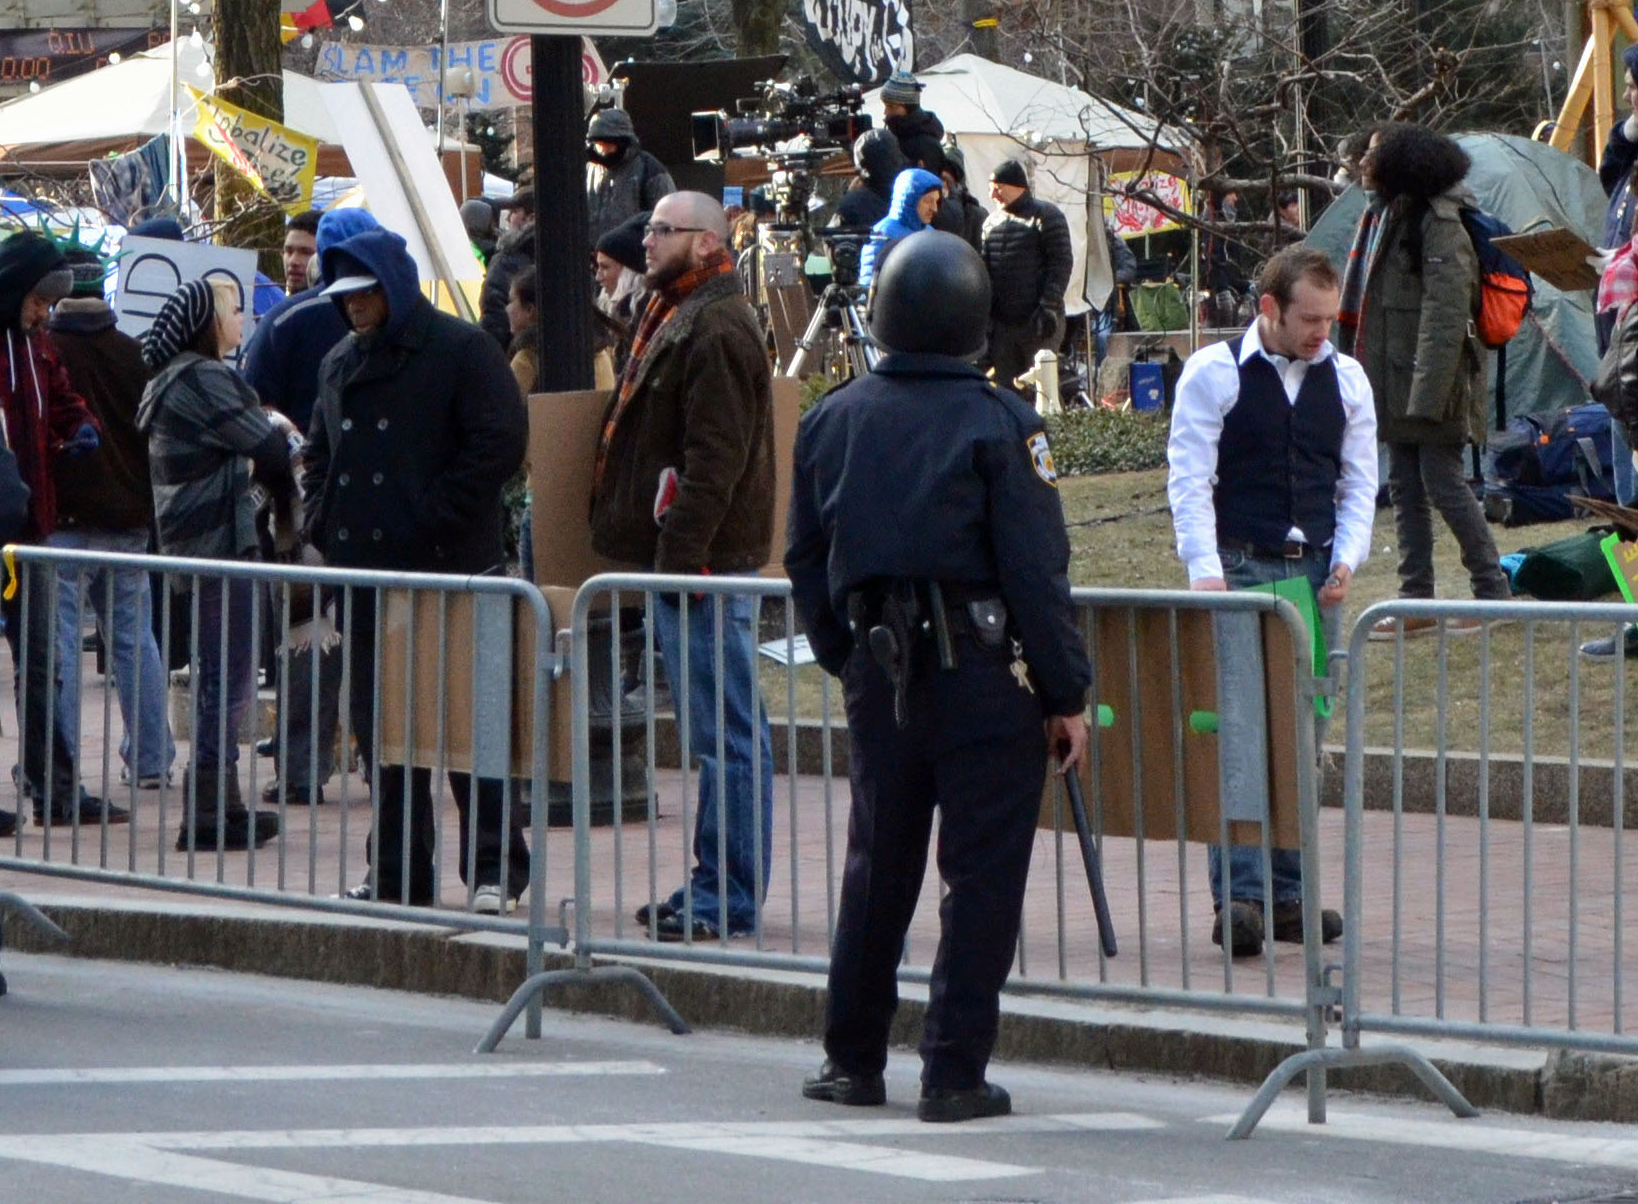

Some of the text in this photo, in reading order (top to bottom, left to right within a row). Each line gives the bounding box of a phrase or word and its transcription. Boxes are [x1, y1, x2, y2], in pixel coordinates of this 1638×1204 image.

[1, 57, 51, 81] 0.00
[312, 43, 497, 74] SLAM THE
